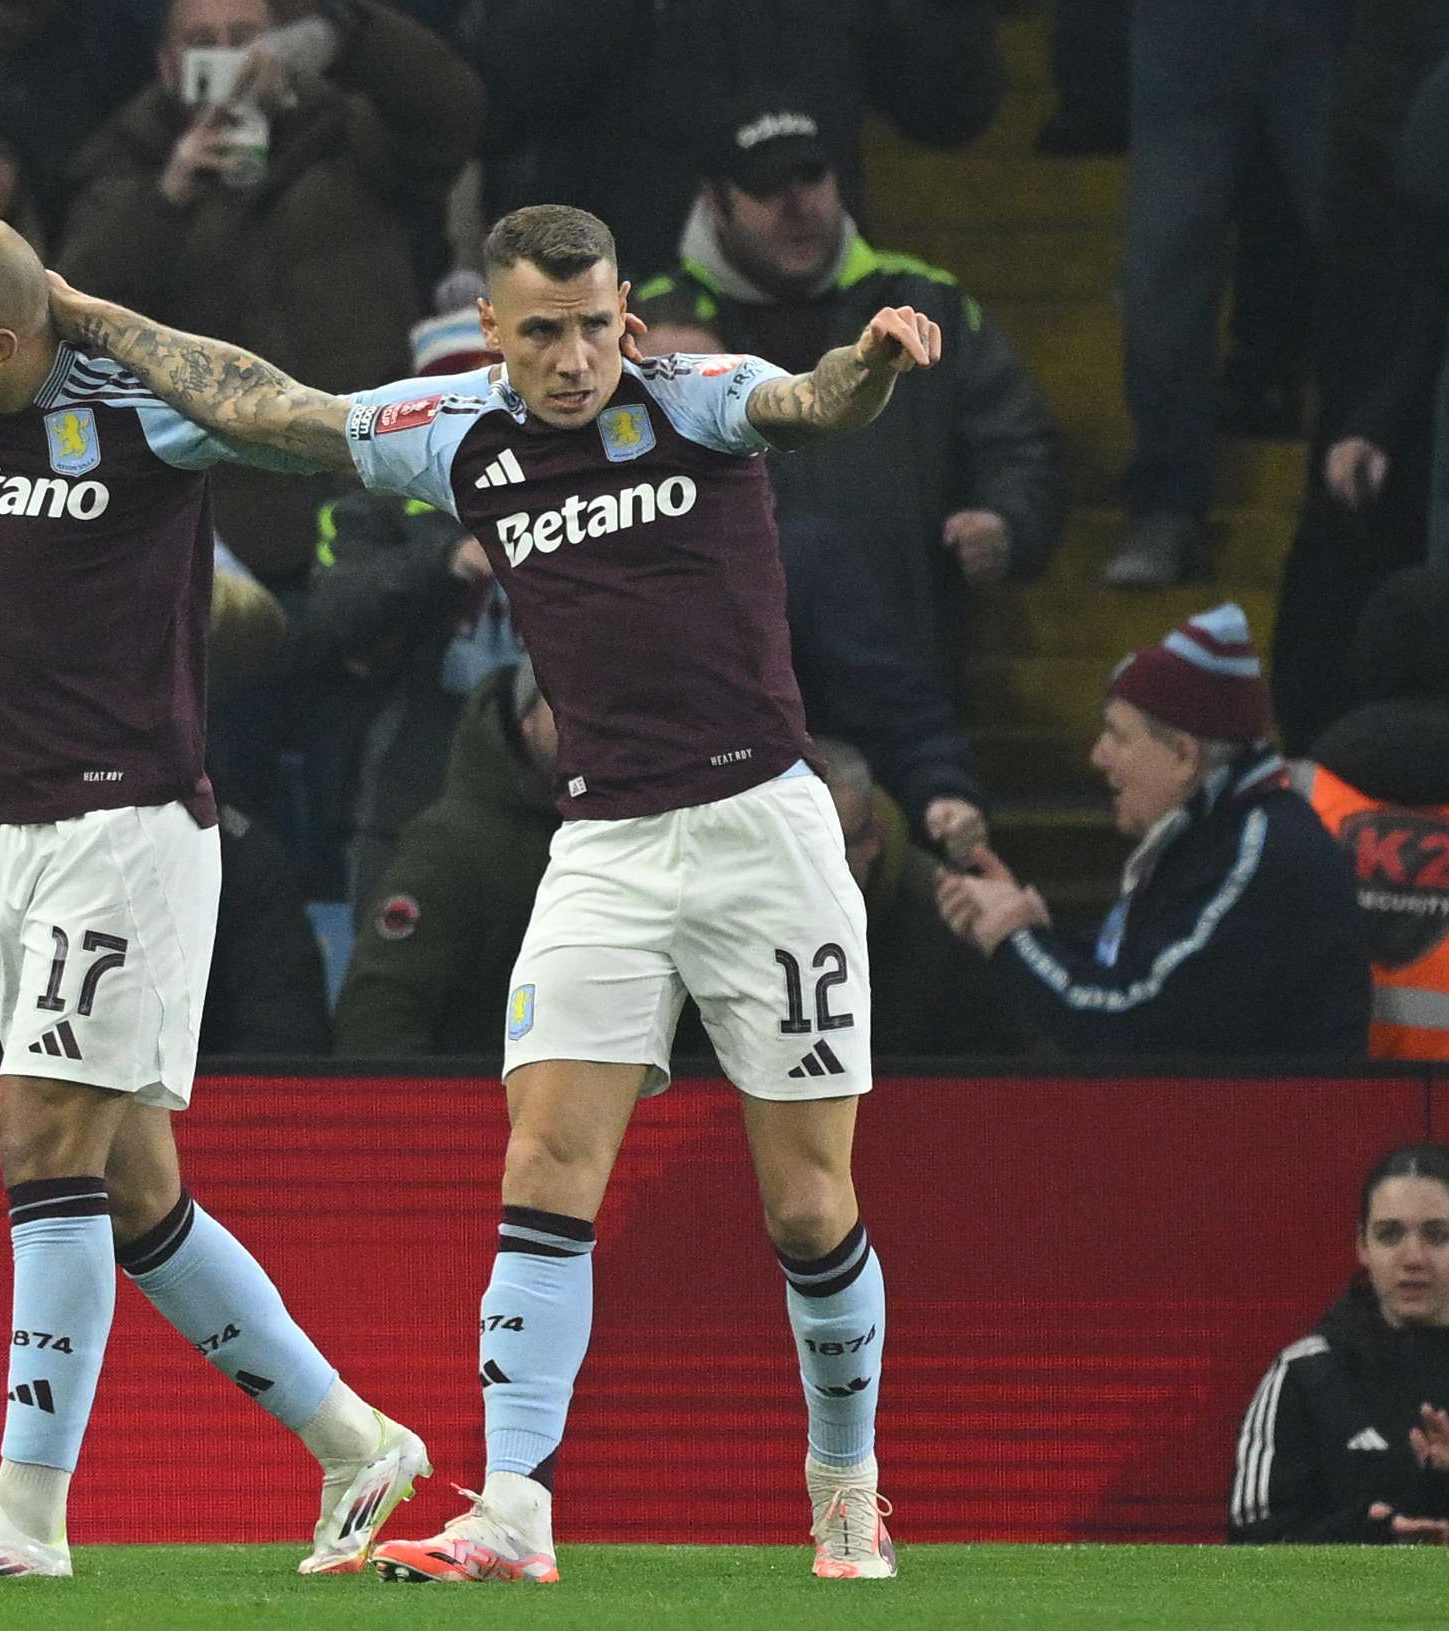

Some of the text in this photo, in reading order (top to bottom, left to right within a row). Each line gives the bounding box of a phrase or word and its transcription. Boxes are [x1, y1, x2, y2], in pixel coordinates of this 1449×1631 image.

[496, 475, 697, 568] Betano
[37, 925, 128, 1016] 17
[775, 942, 855, 1034] 12
[13, 1329, 74, 1355] 874
[195, 1322, 242, 1356] 74
[481, 1315, 525, 1336] 74
